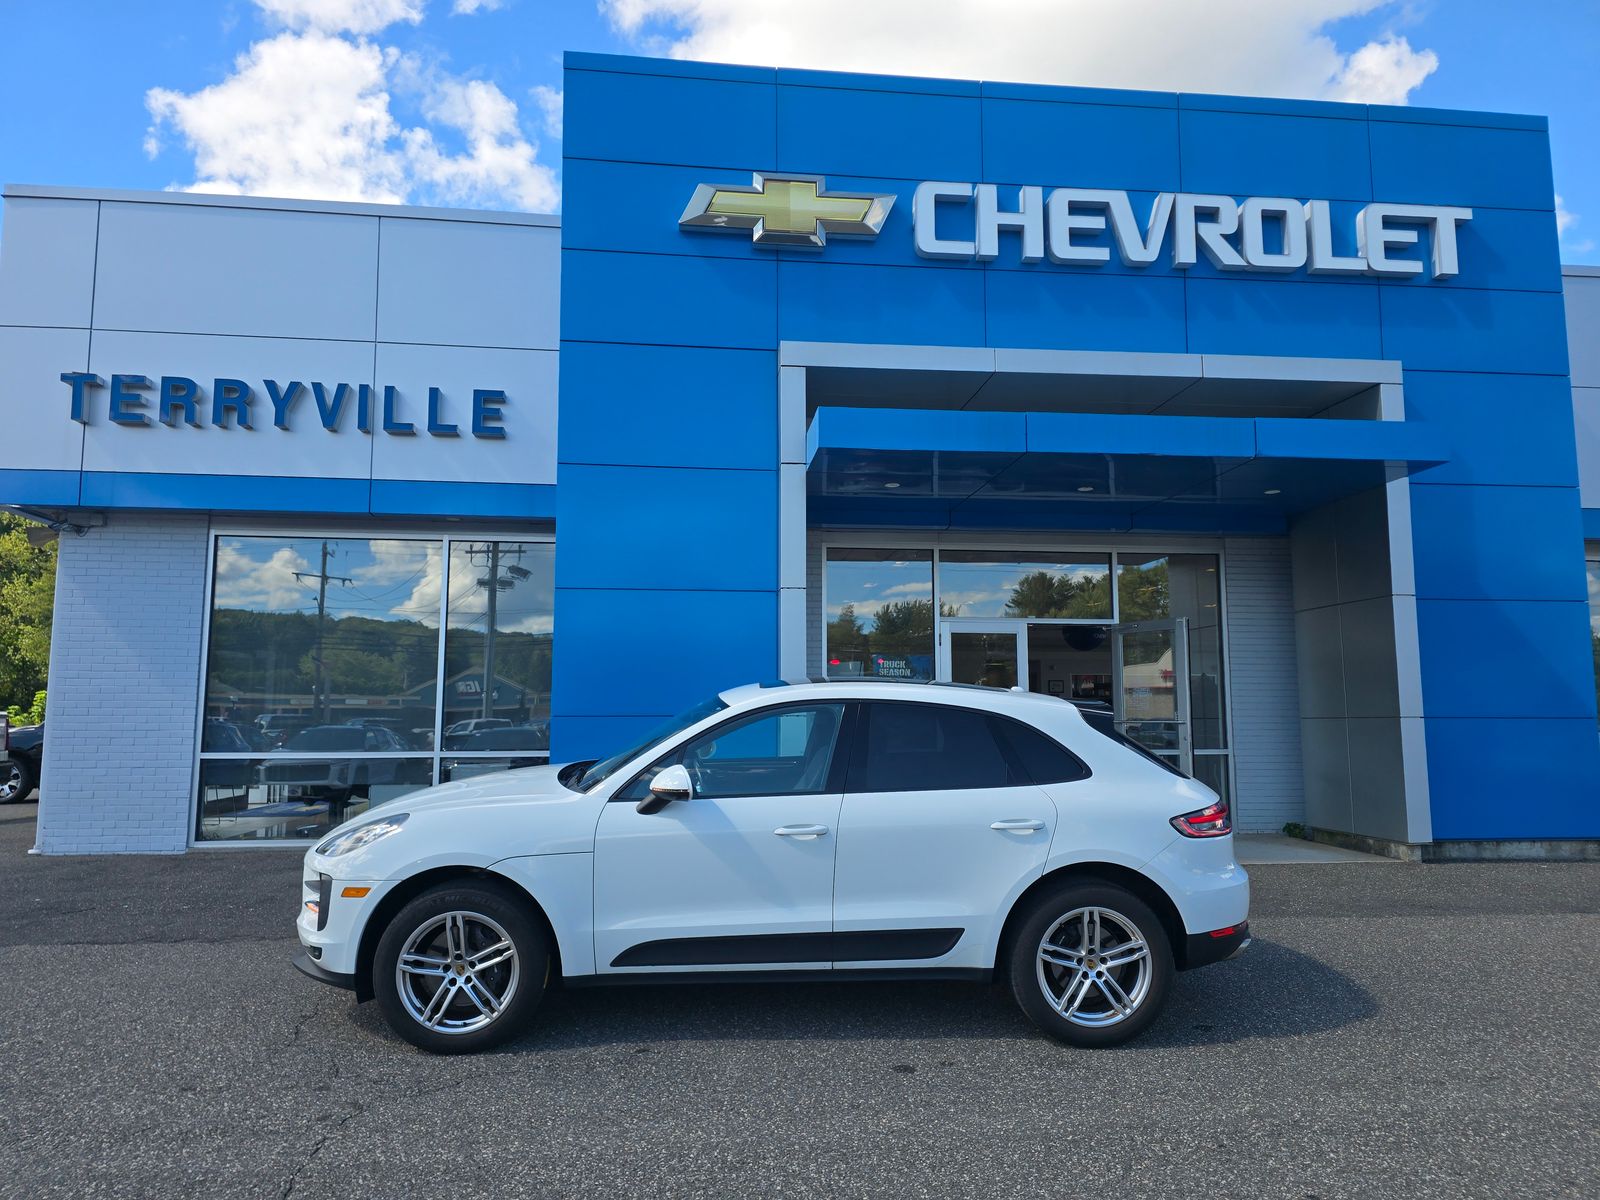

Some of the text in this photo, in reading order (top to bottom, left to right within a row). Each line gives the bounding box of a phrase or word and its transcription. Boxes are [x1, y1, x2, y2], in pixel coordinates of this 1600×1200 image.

[912, 180, 1473, 280] CHEVROLET
[60, 371, 507, 439] TERRYVILLE
[879, 660, 906, 669] TRUCK
[879, 668, 911, 677] SEASON
